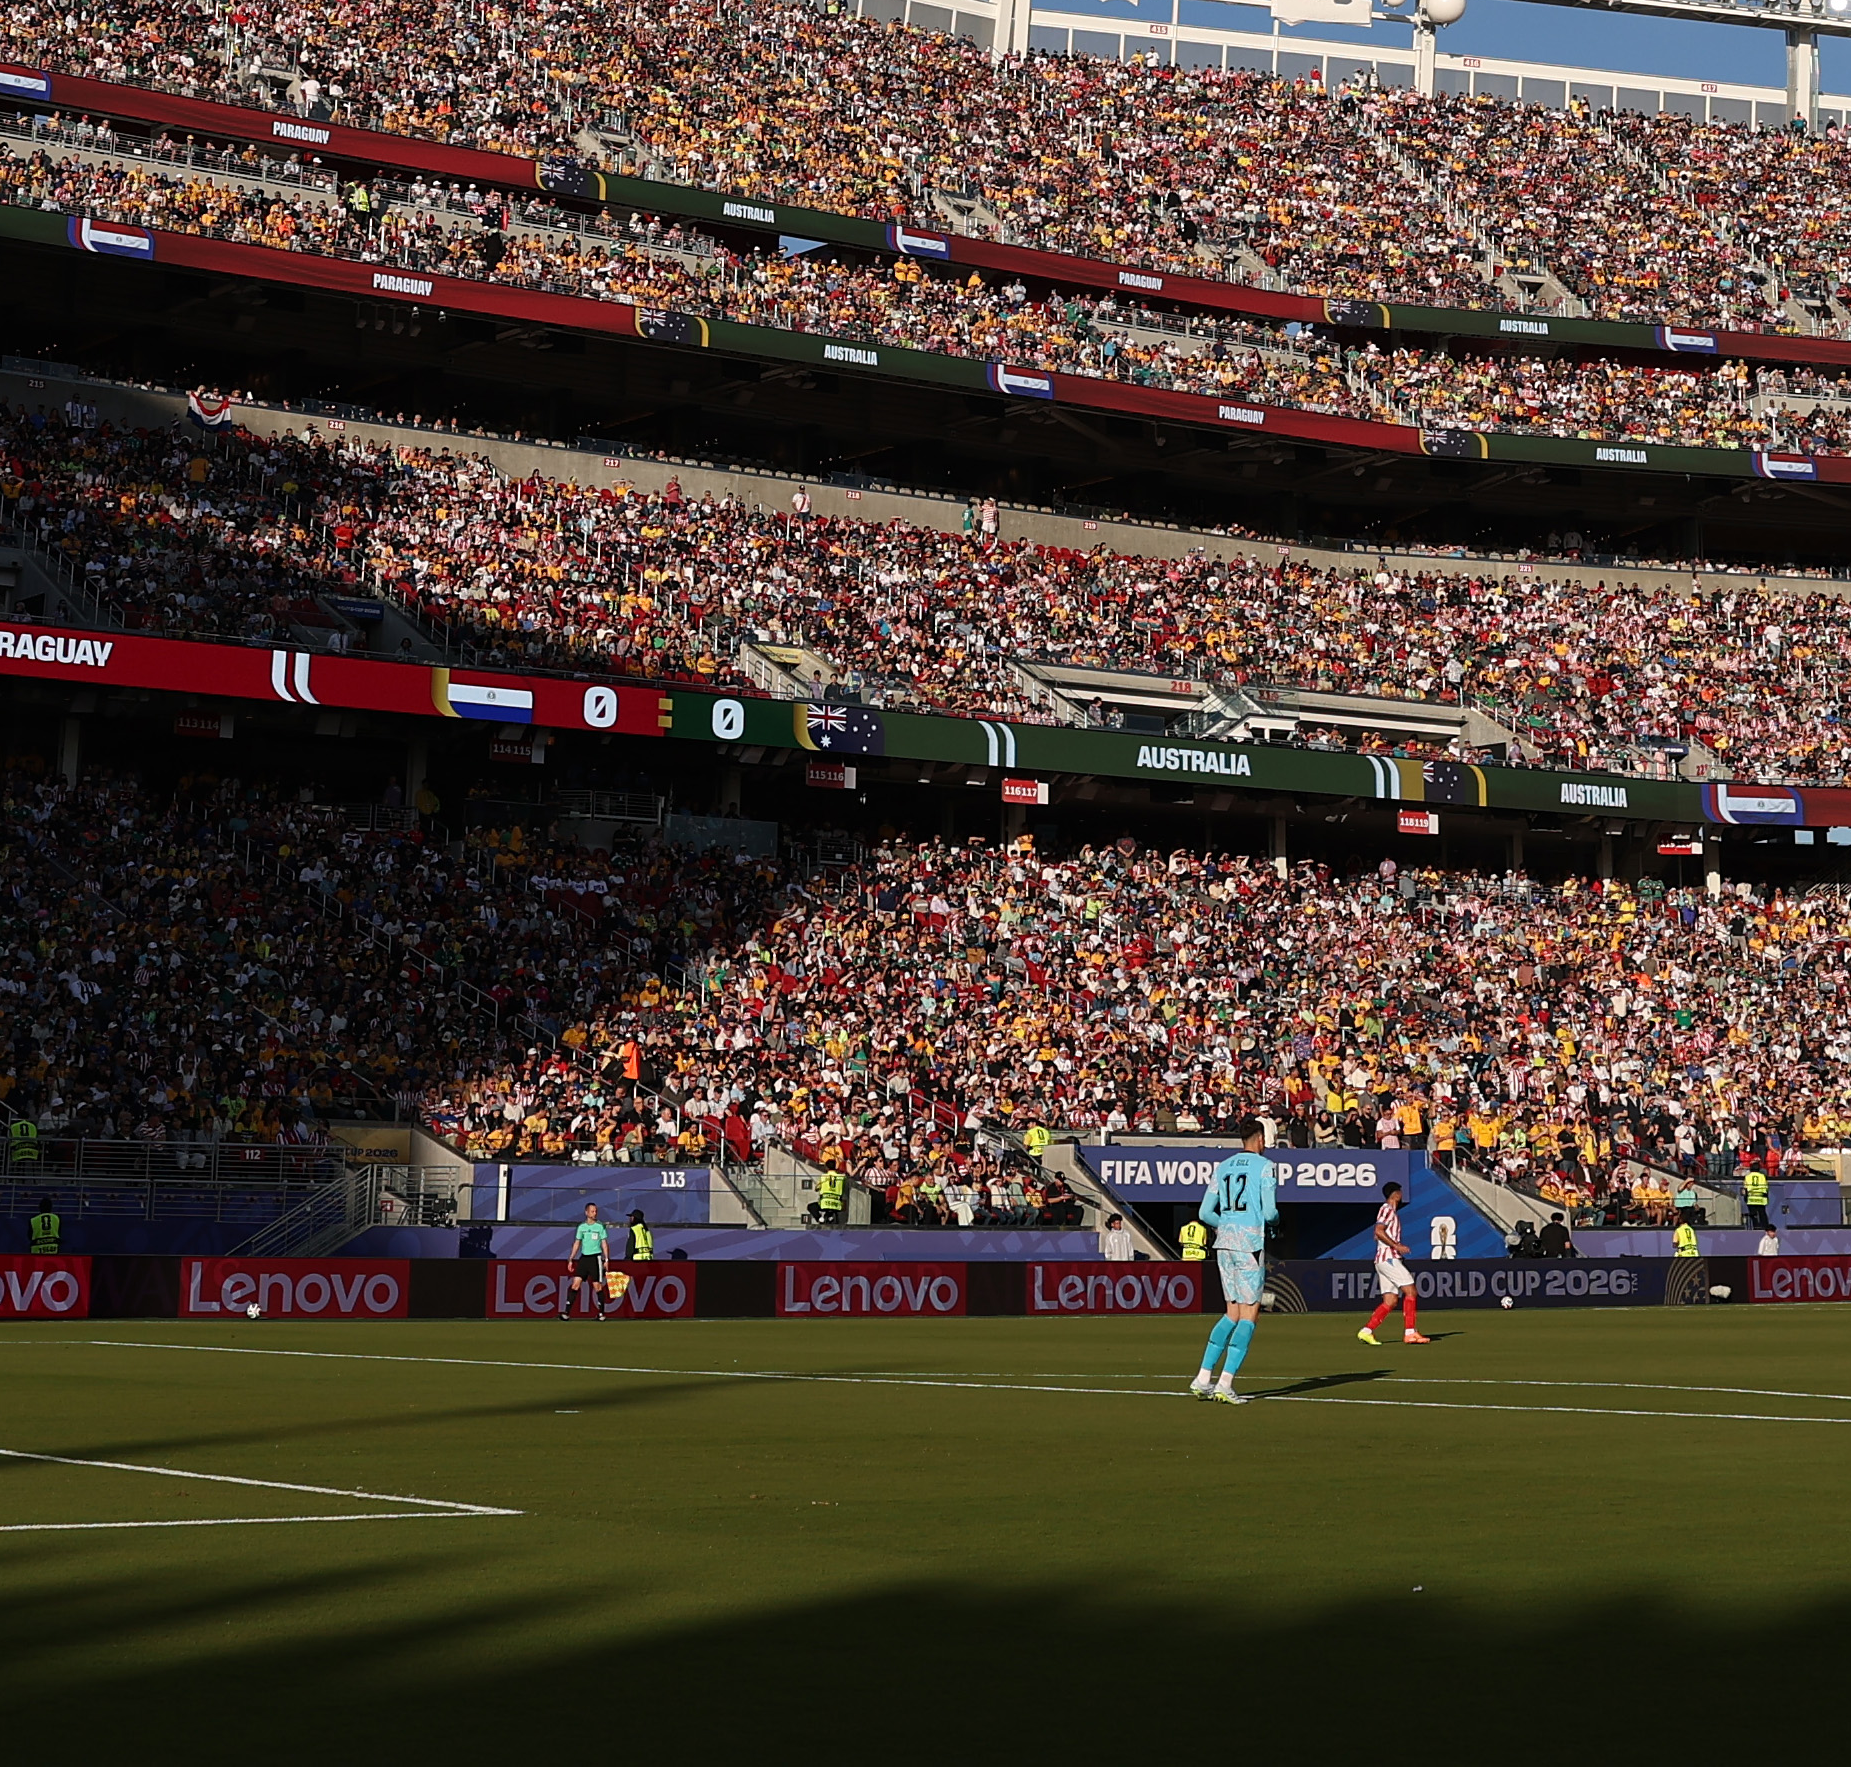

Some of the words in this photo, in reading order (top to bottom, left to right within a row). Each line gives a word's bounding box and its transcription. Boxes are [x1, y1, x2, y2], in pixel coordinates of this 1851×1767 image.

[1151, 25, 1167, 34] 415
[1464, 58, 1479, 67] 416
[1702, 84, 1717, 92] 417
[273, 122, 329, 144] PARAGUAY
[723, 202, 774, 223] AUSTRALIA
[373, 273, 432, 296] PARAGUAY
[1119, 272, 1162, 290] PARAGUAY
[1500, 320, 1548, 334] AUSTRALIA
[824, 345, 877, 365] AUSTRALIA
[29, 380, 44, 388] 215
[1219, 406, 1264, 424] PARAGUAY
[330, 421, 344, 429] 216
[605, 459, 619, 467] 217
[1596, 448, 1647, 463] AUSTRALIA
[1171, 681, 1191, 693] 218
[584, 686, 617, 727] 0
[178, 717, 198, 728] 113
[199, 719, 220, 730] 114
[712, 699, 744, 739] 0
[493, 743, 513, 754] 114
[513, 745, 532, 755] 115
[1137, 746, 1251, 776] AUSTRALIA
[809, 770, 826, 779] 115
[826, 771, 844, 781] 116
[1004, 786, 1021, 795] 116
[1021, 787, 1038, 797] 117
[1561, 783, 1627, 807] AUSTRALIA
[1400, 818, 1414, 826] 118
[1414, 819, 1429, 827] 119
[245, 1150, 261, 1160] 112
[365, 1148, 398, 1157] 2026
[661, 1171, 686, 1188] 113
[1100, 1160, 1152, 1185] FIFA
[1155, 1160, 1218, 1186] WOR
[1296, 1163, 1377, 1187] 2026
[1223, 1173, 1247, 1212] 12
[189, 1262, 399, 1311] Lenovo
[784, 1266, 958, 1311] Lenovo
[1034, 1267, 1195, 1310] Lenovo
[1332, 1272, 1381, 1300] FIFA
[1491, 1270, 1540, 1297] CUP
